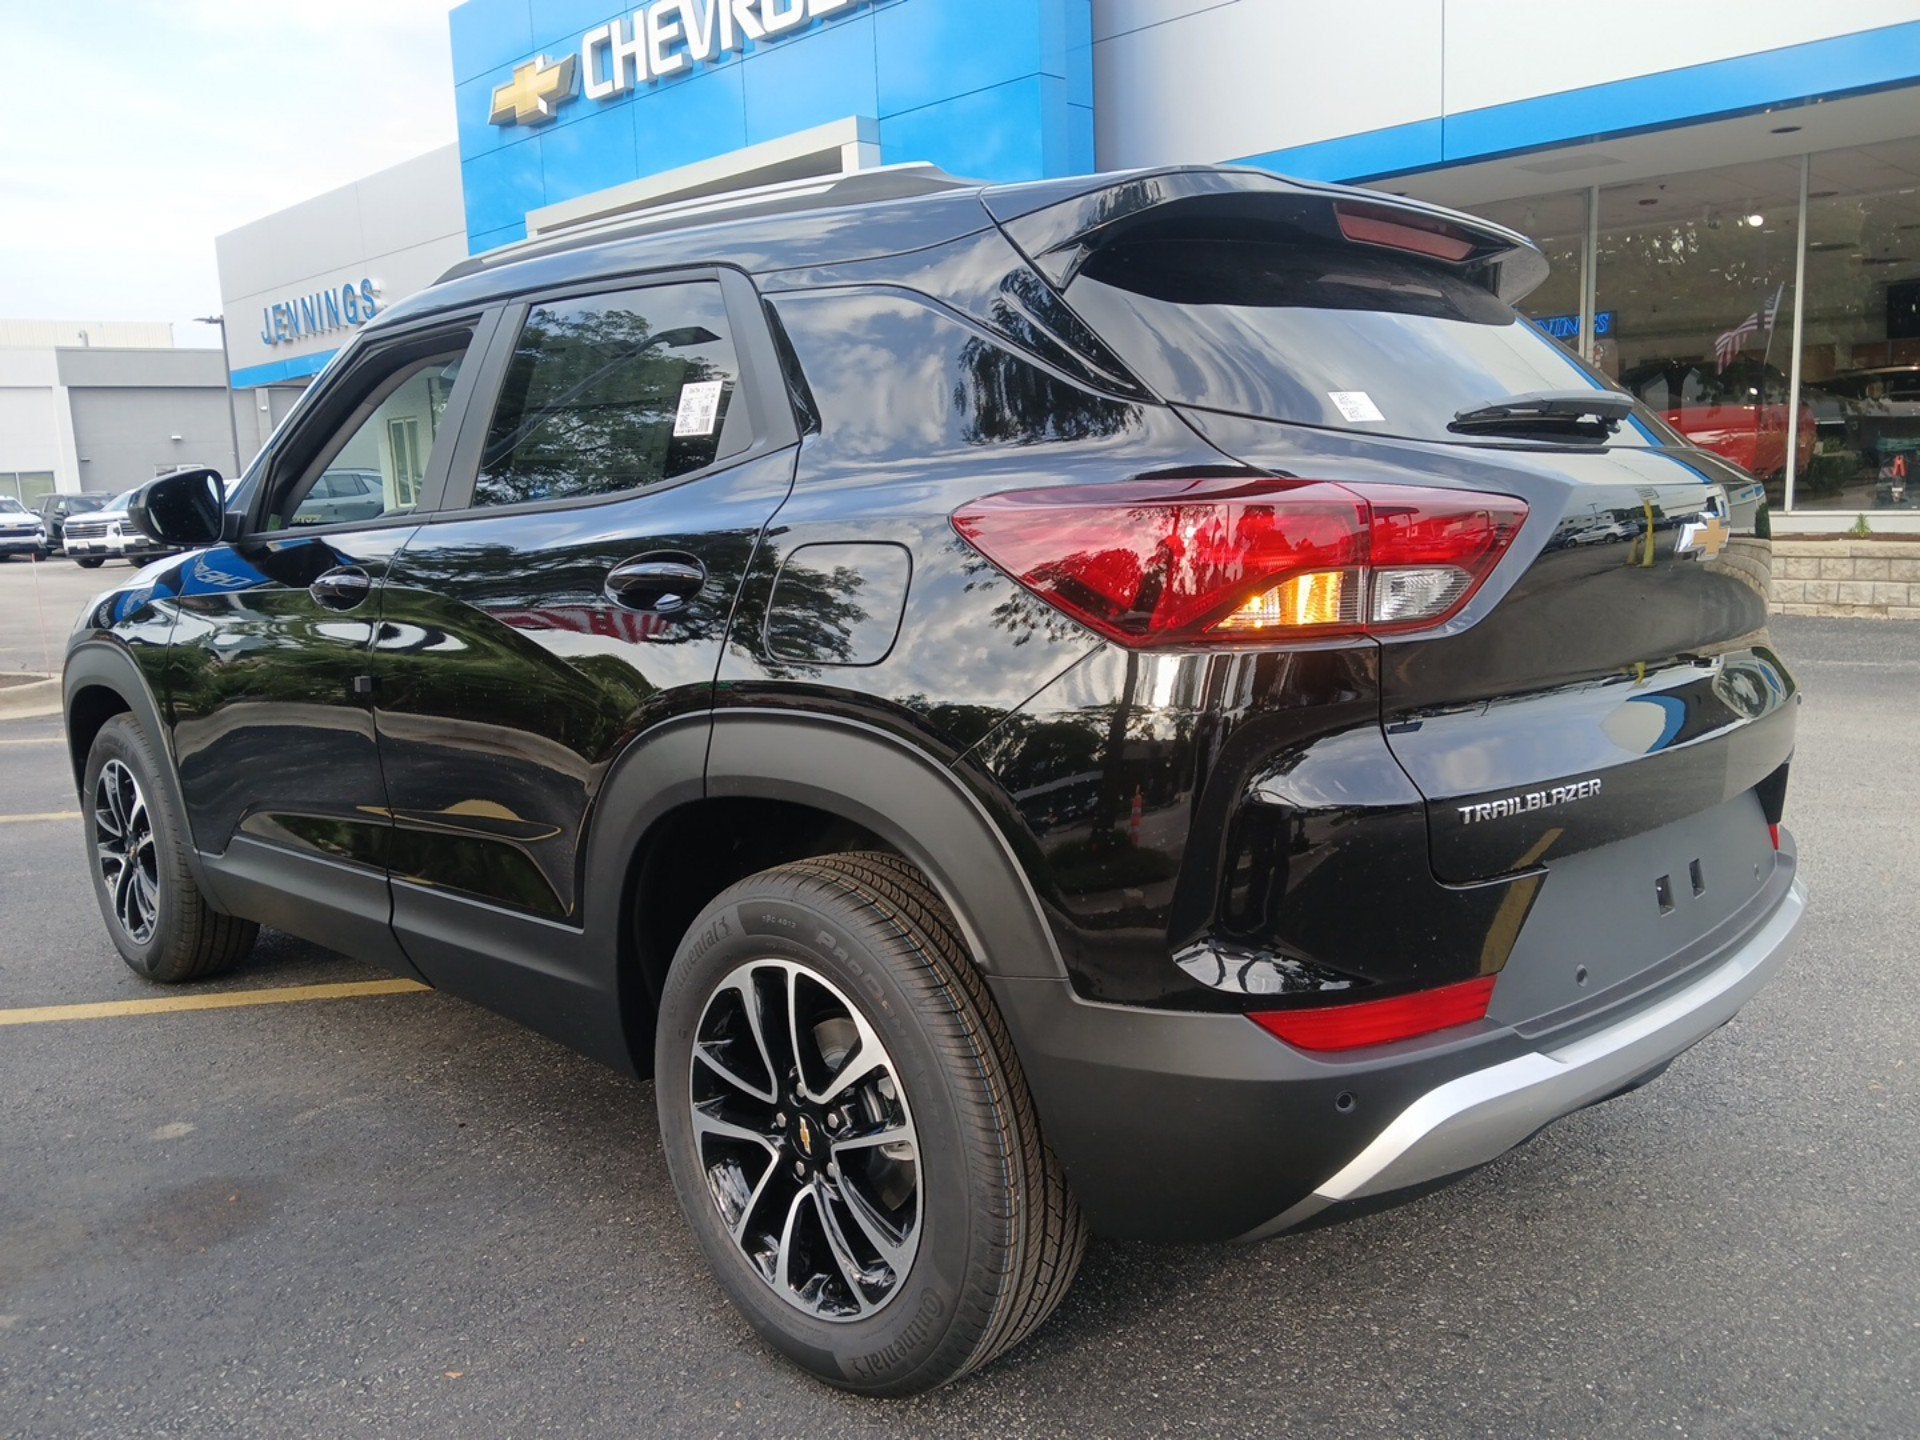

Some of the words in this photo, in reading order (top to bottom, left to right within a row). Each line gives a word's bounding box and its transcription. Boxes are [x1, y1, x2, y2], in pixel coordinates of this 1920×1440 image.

[582, 0, 847, 100] CHEVR
[261, 278, 377, 345] JENNINGS
[1457, 778, 1602, 824] TRAILBLAZER
[864, 1287, 945, 1377] Continental
